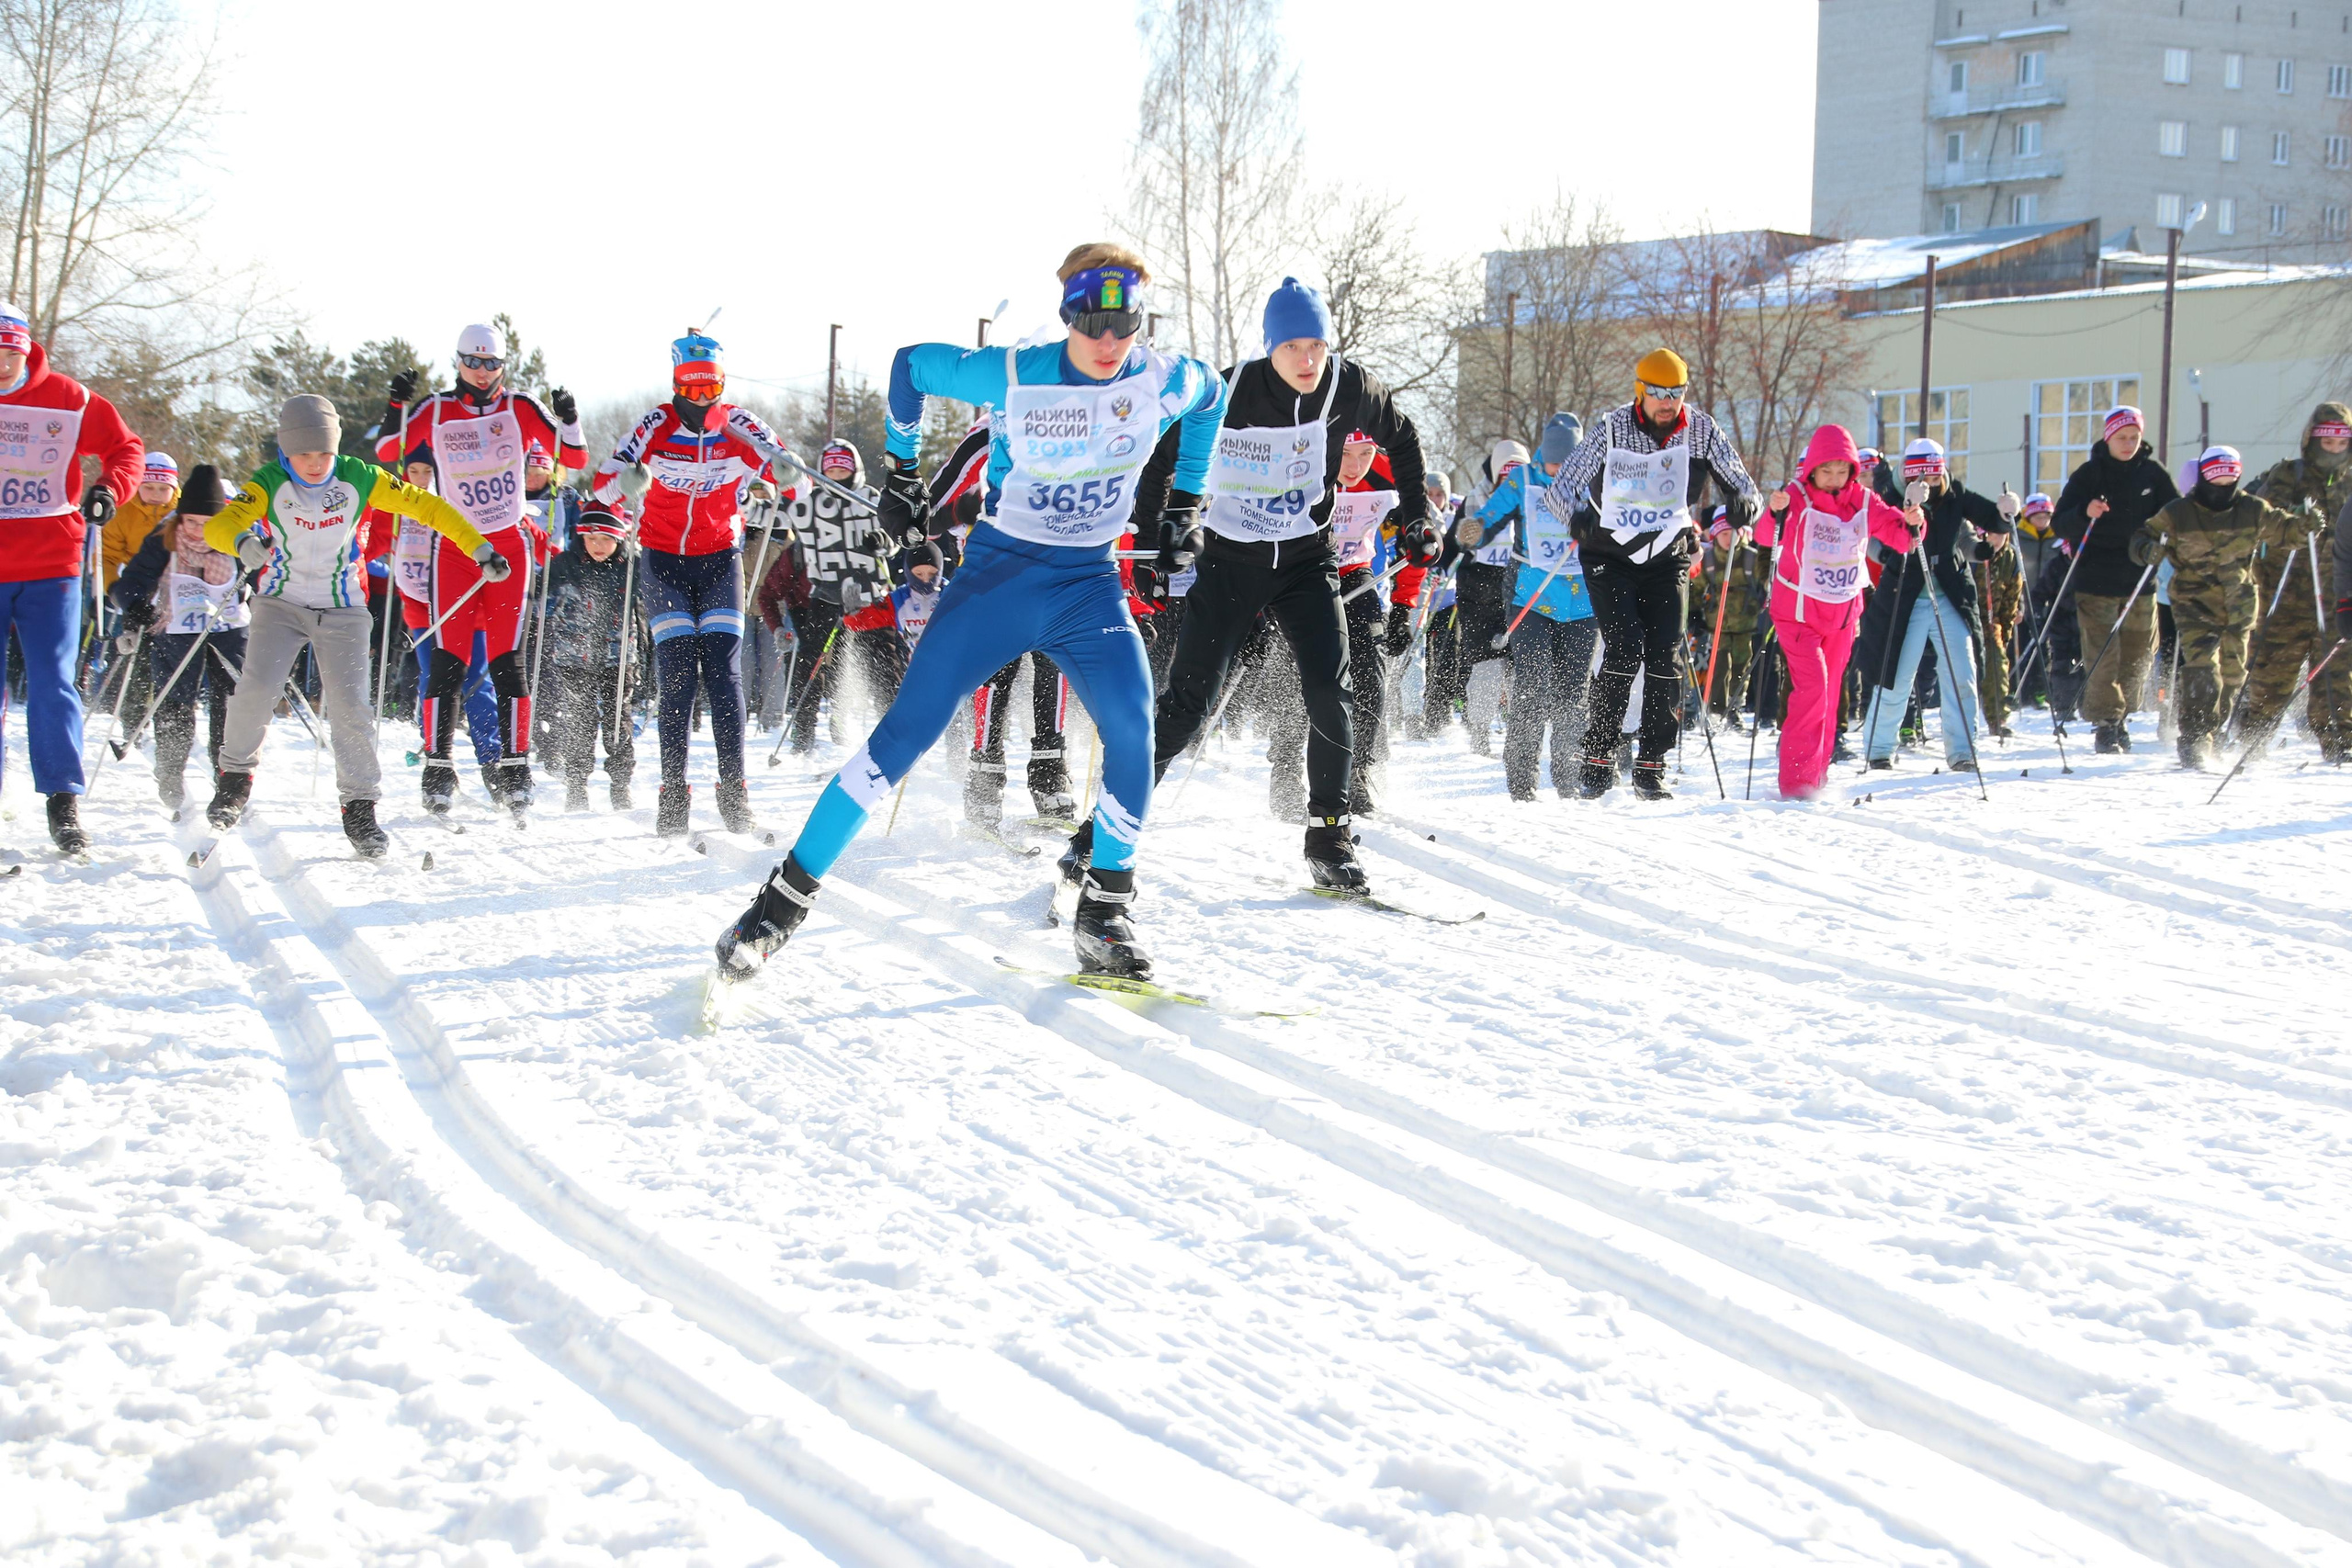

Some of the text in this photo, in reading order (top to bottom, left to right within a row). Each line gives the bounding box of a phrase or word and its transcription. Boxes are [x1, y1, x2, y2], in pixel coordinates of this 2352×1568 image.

[1023, 408, 1089, 423] ЛЫЖНЯ
[443, 431, 480, 442] ЛЫЖНЯ
[1025, 423, 1089, 438] РОССИИ
[445, 441, 482, 451] РОССИИ
[1026, 439, 1088, 457] 2023
[1219, 437, 1272, 455] ЛЫЖНЯ
[1220, 446, 1272, 463] РОССИИ
[1611, 461, 1648, 472] ЛЫЖНЯ
[2, 478, 51, 506] 686
[458, 470, 517, 507] 3698
[1029, 474, 1126, 513] 3655
[473, 499, 513, 517] ТЮМЕНСКАЯ
[1239, 505, 1292, 529] ТЮМЕНСКАЯ
[1814, 566, 1858, 589] 3390
